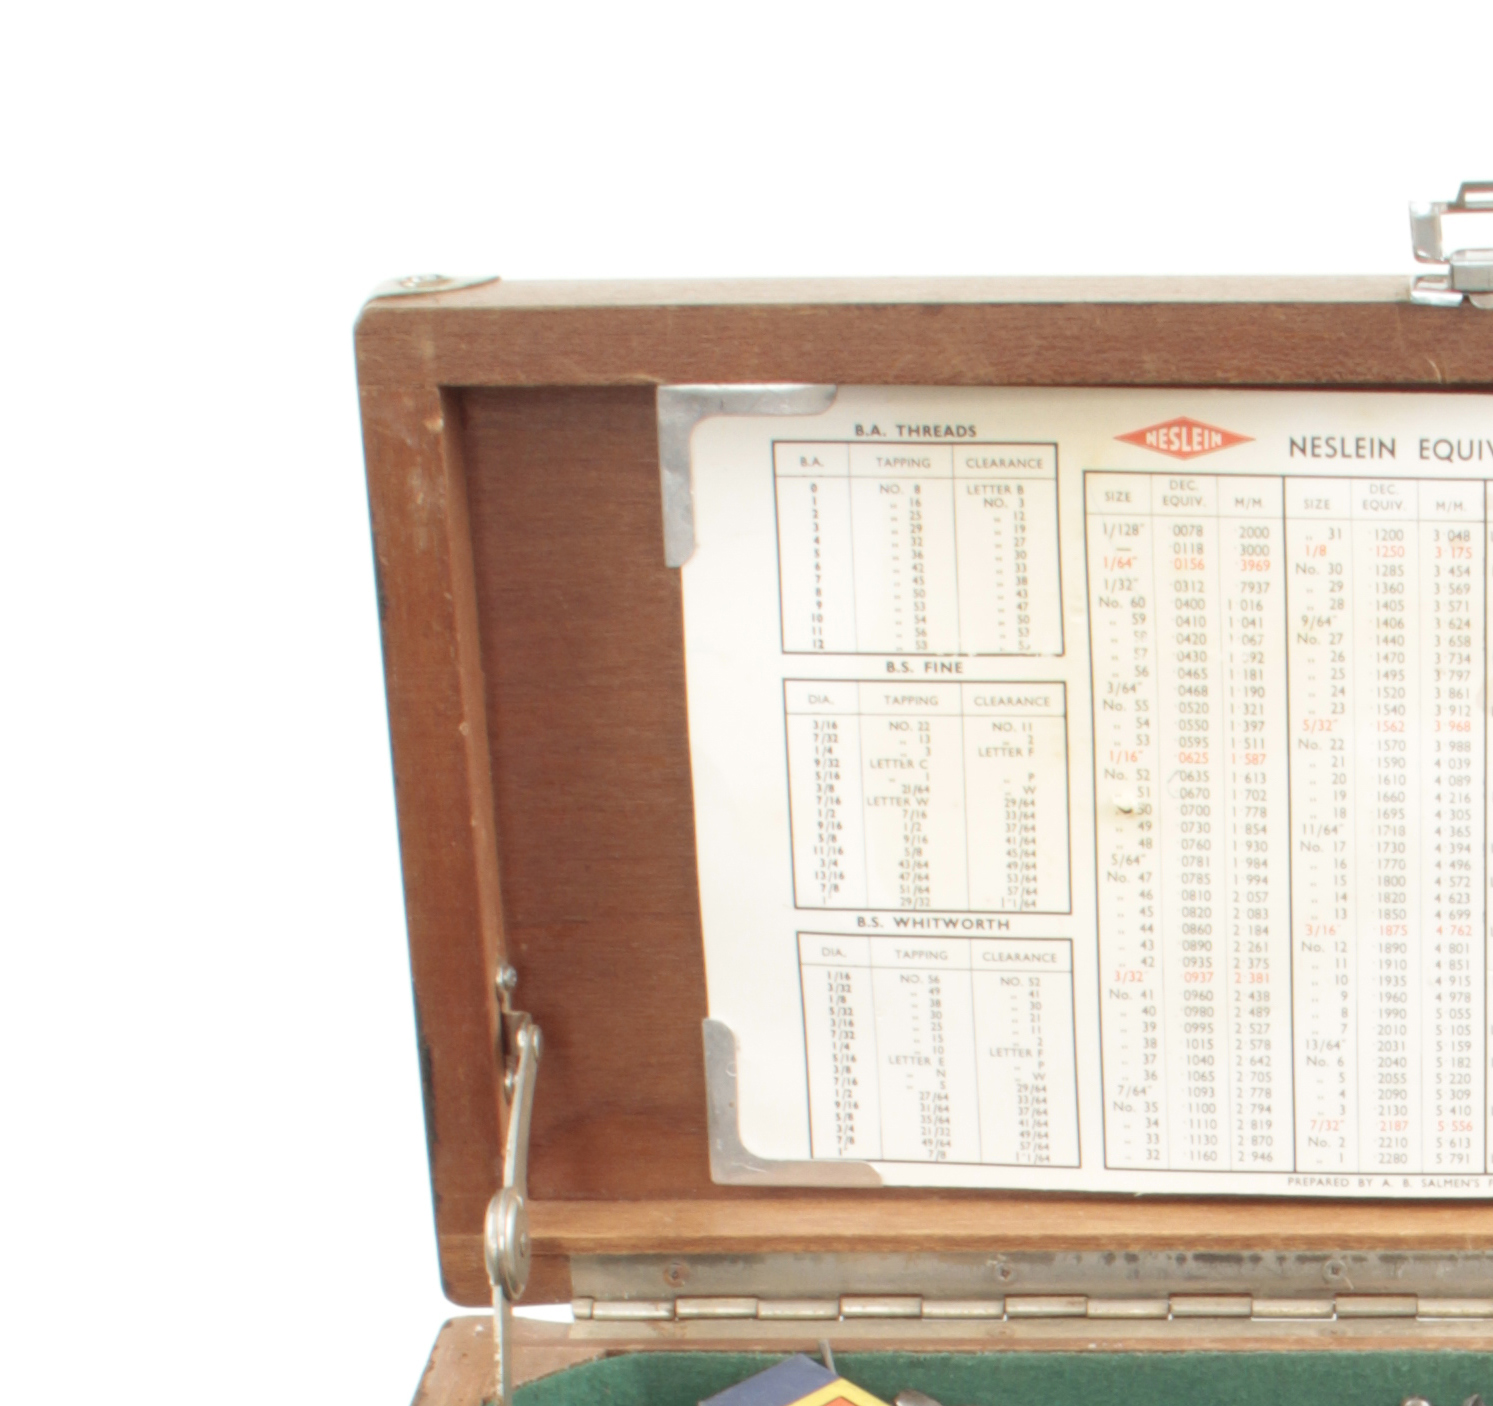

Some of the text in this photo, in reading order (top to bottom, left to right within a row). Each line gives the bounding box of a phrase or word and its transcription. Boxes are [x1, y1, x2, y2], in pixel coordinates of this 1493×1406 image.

[855, 424, 977, 438] B.A. THREADS
[1146, 426, 1223, 452] NESLEIN
[1289, 436, 1397, 460] NESLEIN
[800, 456, 1044, 470] B.A. TAPPING CLEARANCE
[879, 484, 904, 495] NO.
[966, 484, 1011, 495] LETTER
[1169, 480, 1198, 491] DEC.
[1369, 483, 1399, 495] DEC.
[811, 495, 817, 507] 1
[983, 498, 1008, 509] NO.
[1105, 491, 1132, 503] SIZE
[1162, 495, 1207, 508] EQUIV.
[1303, 499, 1331, 510] SIZE
[1362, 500, 1407, 512] EQUIV.
[812, 509, 819, 520] 2
[813, 522, 819, 533] 3
[813, 535, 820, 546] 4
[813, 548, 820, 559] 5
[814, 561, 821, 573] 6
[1327, 563, 1343, 576] 30
[1329, 581, 1344, 593] 29
[1130, 597, 1146, 609] 60
[1329, 598, 1345, 611] 28
[1131, 613, 1147, 626] 59
[1328, 633, 1343, 646] 27
[886, 661, 964, 674] B.S. FINE
[808, 694, 1050, 707] DIA. TAPPING CLEARANCE
[889, 721, 913, 732] NO.
[917, 721, 930, 732] 22
[978, 747, 1024, 758] LETTER
[869, 759, 915, 770] LETTER
[866, 796, 911, 807] LETTER
[1332, 841, 1347, 853] 17
[857, 916, 1011, 931] B.S. WHITWORTH
[821, 947, 1057, 963] DIA. TAPPING CLEARANCE
[989, 1047, 1033, 1058] LETTER
[888, 1055, 931, 1066] LETTER
[1287, 1177, 1350, 1188] PREPARED
[1358, 1177, 1374, 1188] BY
